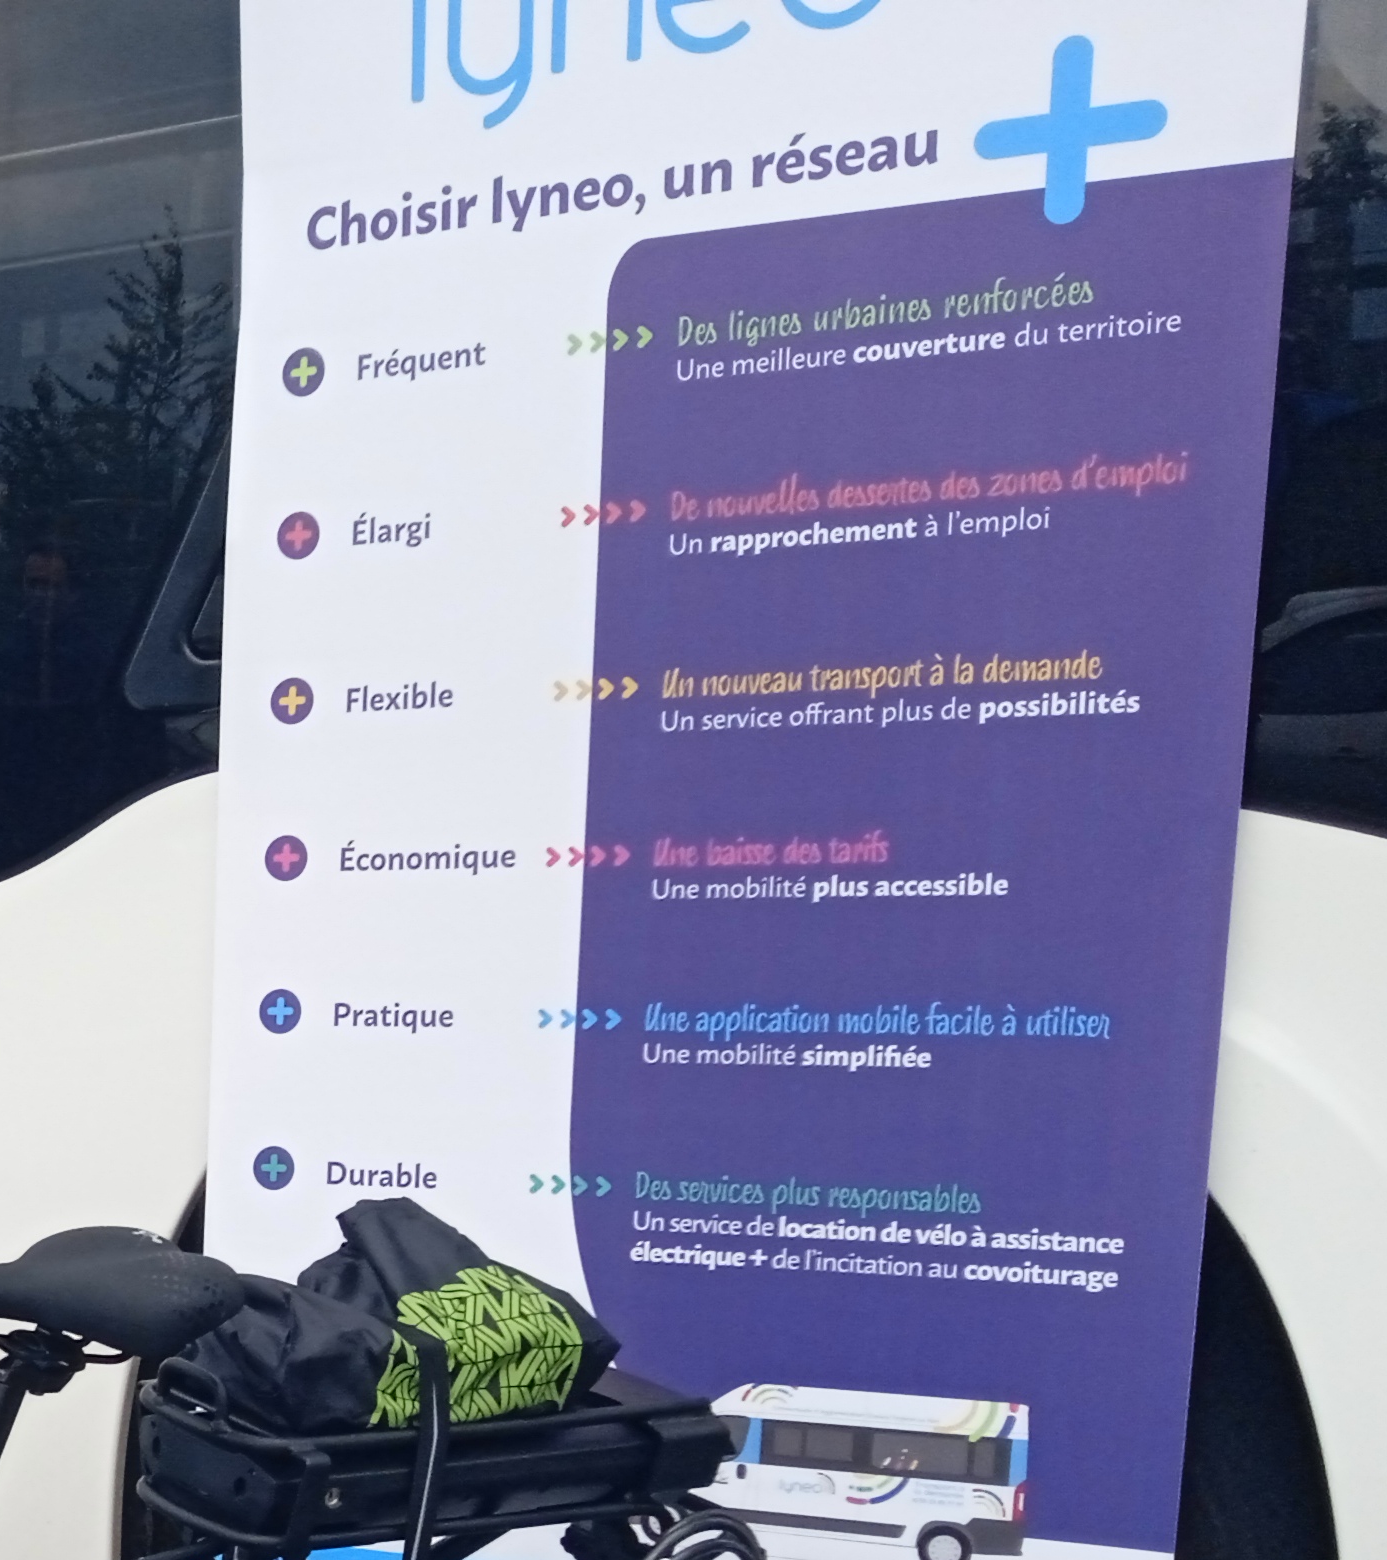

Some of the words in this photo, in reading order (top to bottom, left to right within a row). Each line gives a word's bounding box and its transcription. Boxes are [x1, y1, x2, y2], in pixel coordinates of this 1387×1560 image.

[306, 185, 478, 251] Choisir
[491, 173, 647, 233] lyneo,
[663, 158, 734, 201] un
[751, 129, 940, 188] réseau
[677, 314, 718, 348] Des
[726, 308, 804, 345] lignes
[813, 294, 933, 334] urbaines
[942, 272, 1095, 319] renforcées
[356, 341, 487, 383] Fréquent
[675, 356, 725, 382] Une
[731, 342, 848, 374] meilleure
[853, 328, 1006, 365] couverture
[1013, 319, 1049, 349] du
[1057, 311, 1183, 344] territoire
[671, 489, 701, 523] De
[706, 473, 821, 520] nouvelles
[826, 476, 933, 513] dessertes
[938, 471, 981, 505] des
[988, 467, 1063, 497] zones
[1070, 450, 1189, 496] d'emploi
[351, 512, 432, 548] Élargi
[668, 531, 704, 557] Un
[708, 516, 918, 557] rapprochement
[923, 512, 940, 537] à
[946, 506, 1052, 538] l'emploi
[662, 665, 696, 699] Un
[700, 663, 804, 697] nouveau
[809, 657, 924, 697] transport
[929, 654, 946, 686] à
[953, 654, 975, 686] la
[982, 648, 1105, 685] demande
[345, 680, 454, 713] Flexible
[660, 709, 695, 733] Un
[700, 702, 784, 731] service
[788, 697, 875, 728] offrant
[880, 695, 935, 727] plus
[939, 695, 973, 722] de
[978, 689, 1141, 726] possibilités
[339, 840, 517, 876] Économique
[652, 837, 701, 868] Une
[705, 837, 777, 867] baisse
[783, 837, 822, 866] des
[828, 829, 890, 865] tarifs
[651, 878, 701, 900] Une
[705, 874, 807, 900] mobilité
[811, 874, 870, 905] plus
[873, 872, 1010, 898] accessible
[333, 1002, 455, 1034] Pratique
[643, 1003, 691, 1034] Une
[694, 1004, 831, 1043] application
[837, 1003, 922, 1038] mobile
[924, 1000, 996, 1041] facile
[1001, 1004, 1018, 1038] à
[1026, 1004, 1113, 1041] utiliser
[642, 1043, 691, 1066] Une
[696, 1041, 797, 1068] mobilité
[800, 1044, 933, 1073] simplifiée
[327, 1160, 438, 1189] Durable
[634, 1169, 673, 1202] Des
[677, 1173, 766, 1207] services
[770, 1177, 822, 1214] plus
[827, 1180, 983, 1217] responsables
[632, 1210, 666, 1234] Un
[669, 1214, 741, 1237] service
[745, 1215, 775, 1238] de
[777, 1217, 878, 1246] location
[880, 1222, 913, 1247] de
[914, 1221, 969, 1248] vélo
[971, 1224, 988, 1250] à
[990, 1228, 1126, 1256] assistance
[629, 1241, 747, 1272] électrique
[771, 1249, 800, 1272] de
[802, 1249, 923, 1279] l'incitation
[927, 1259, 959, 1281] au
[963, 1261, 1120, 1293] covoiturage
